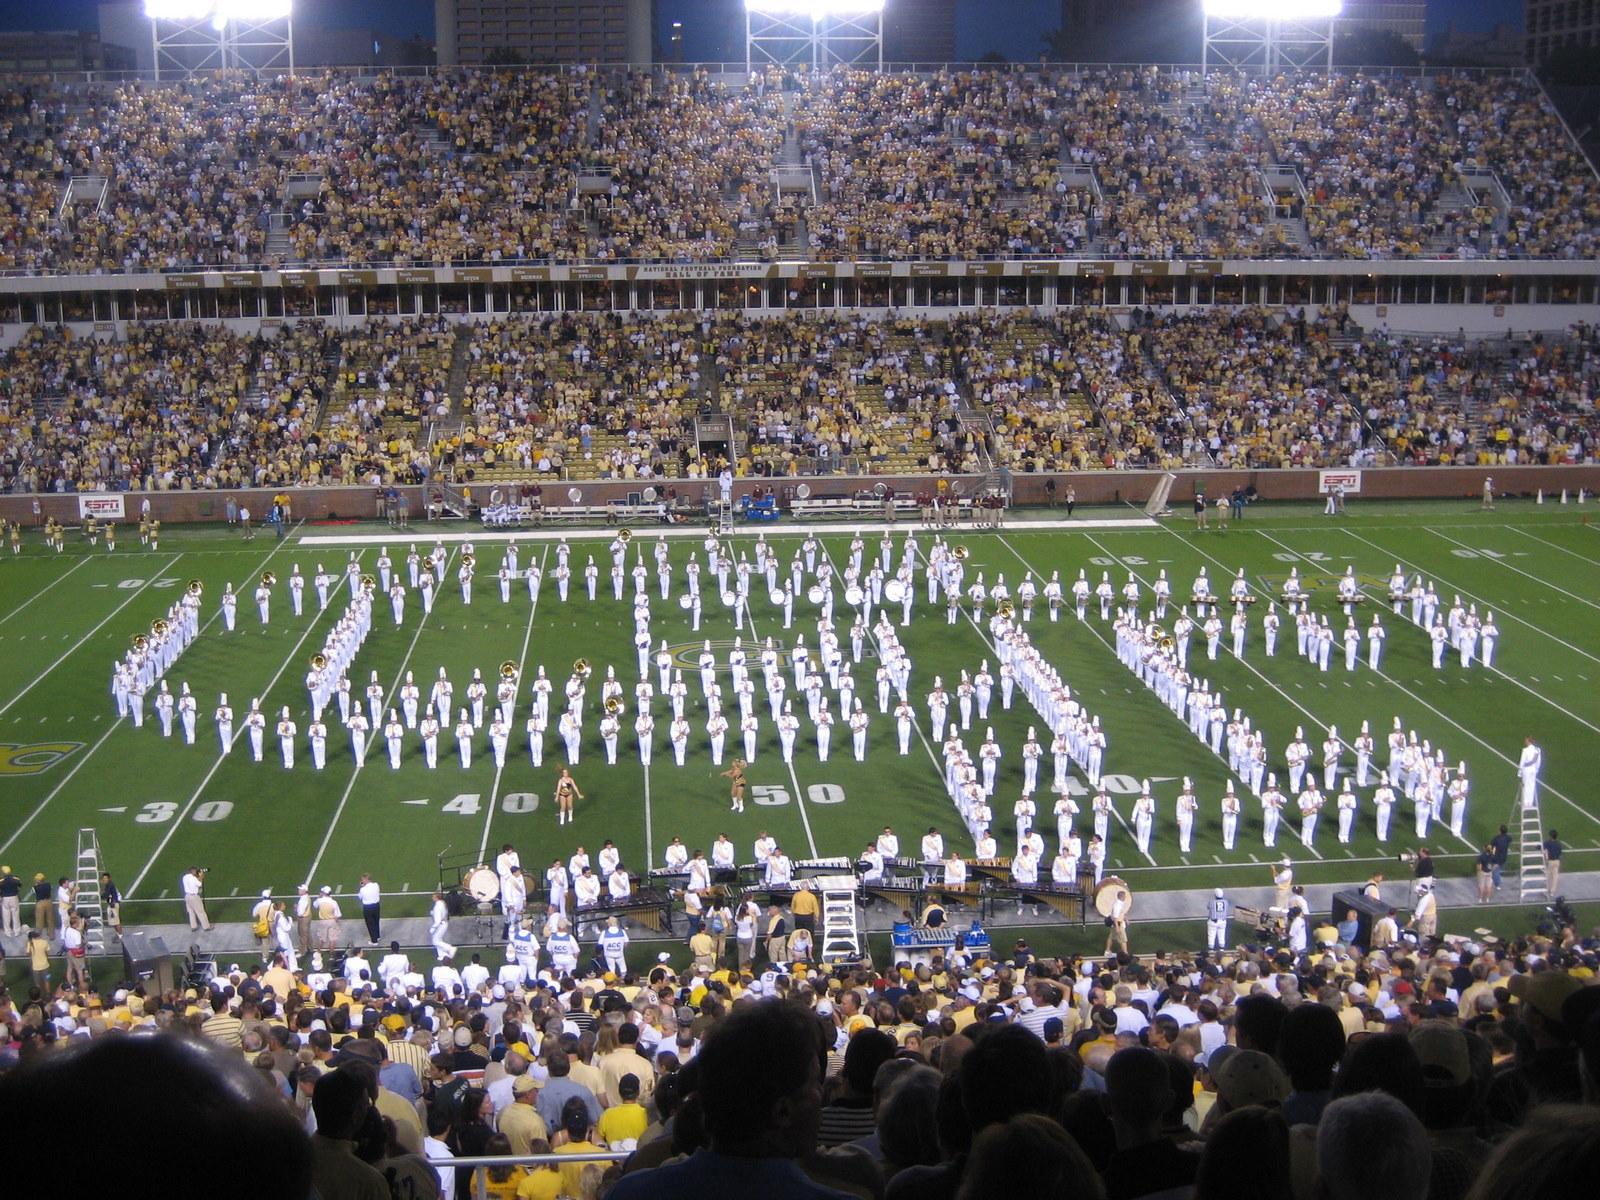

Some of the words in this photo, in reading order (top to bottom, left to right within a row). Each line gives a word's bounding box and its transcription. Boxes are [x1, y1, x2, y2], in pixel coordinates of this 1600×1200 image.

[1324, 474, 1356, 484] ESPN
[85, 499, 119, 509] ESPN
[442, 793, 539, 815] 40
[752, 783, 845, 804] 50
[136, 802, 234, 823] 30
